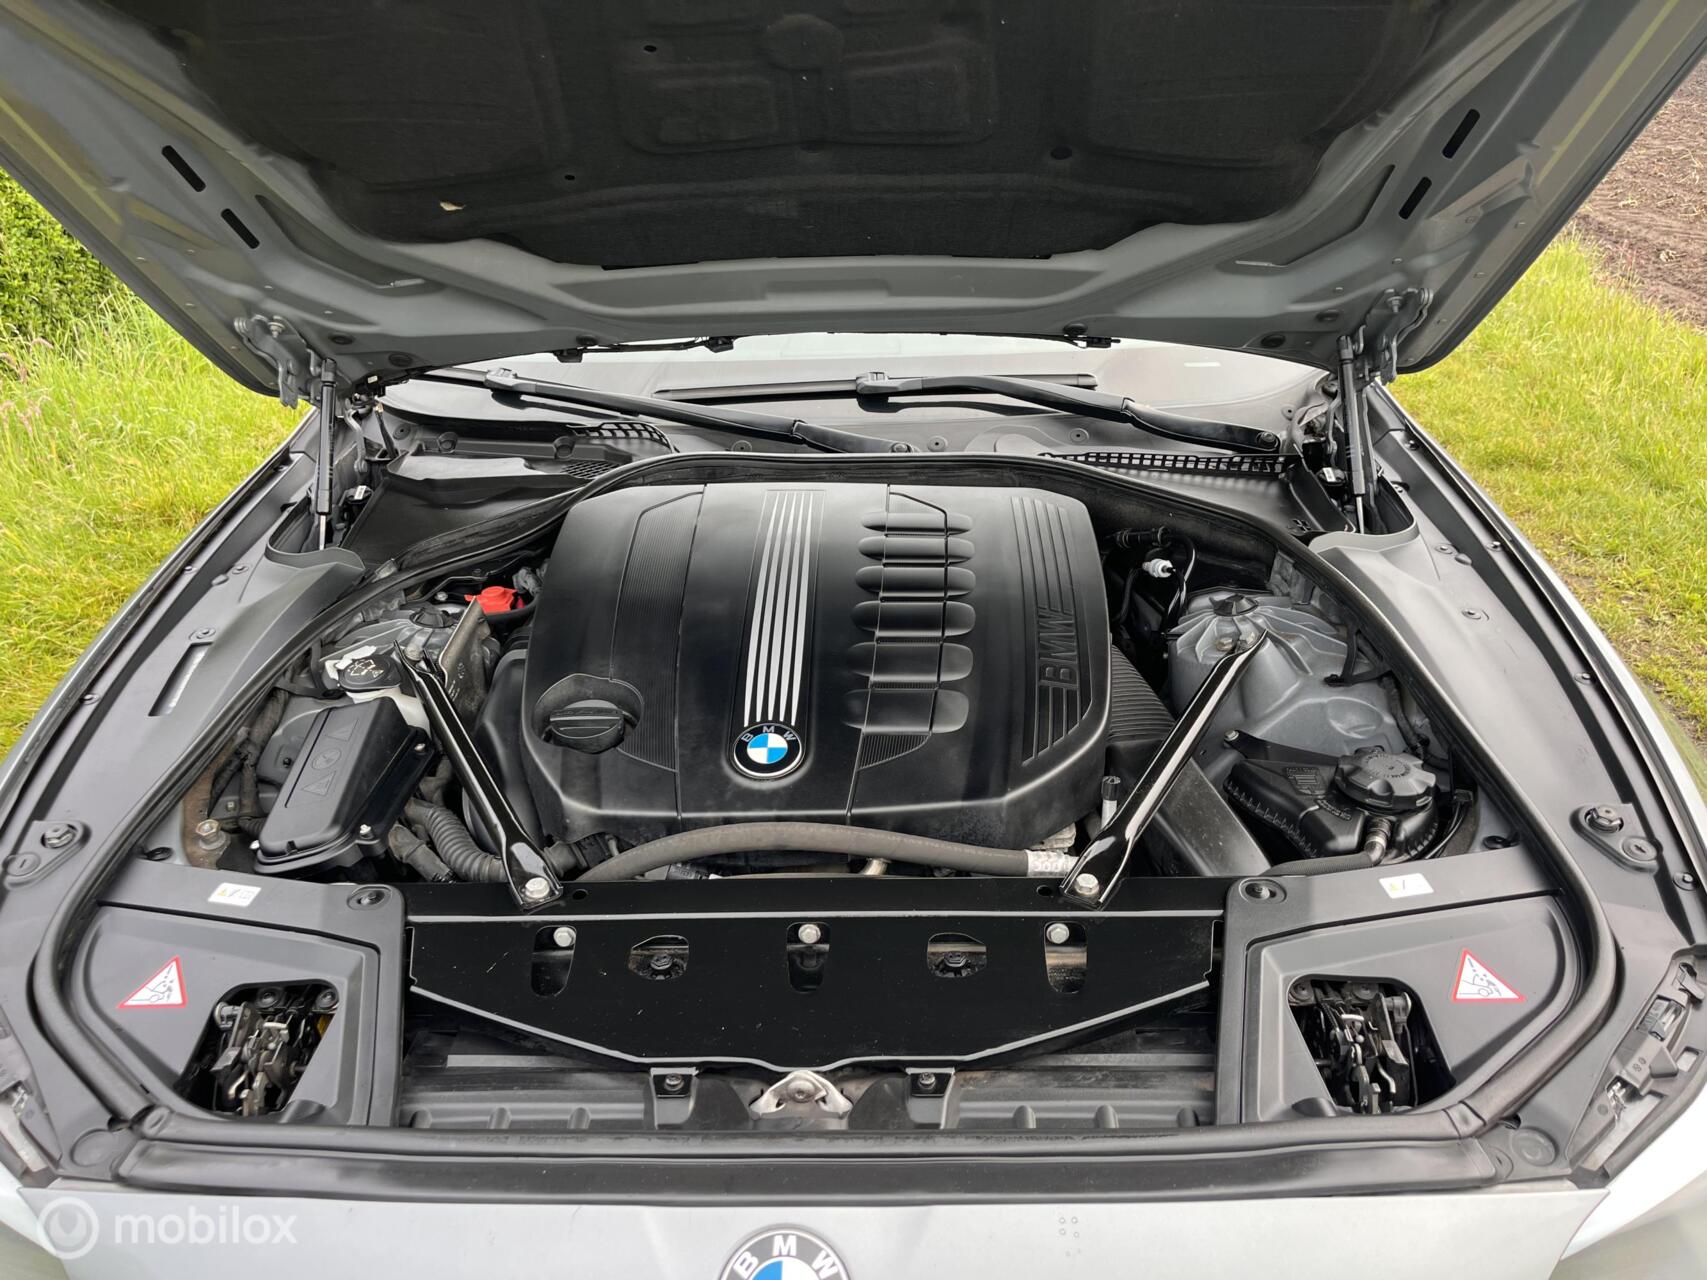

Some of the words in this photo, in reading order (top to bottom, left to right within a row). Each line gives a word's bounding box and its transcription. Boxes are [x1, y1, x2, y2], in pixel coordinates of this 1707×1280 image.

[1037, 605, 1078, 688] BMW
[741, 726, 797, 743] BMW
[733, 1235, 839, 1280] BMW
